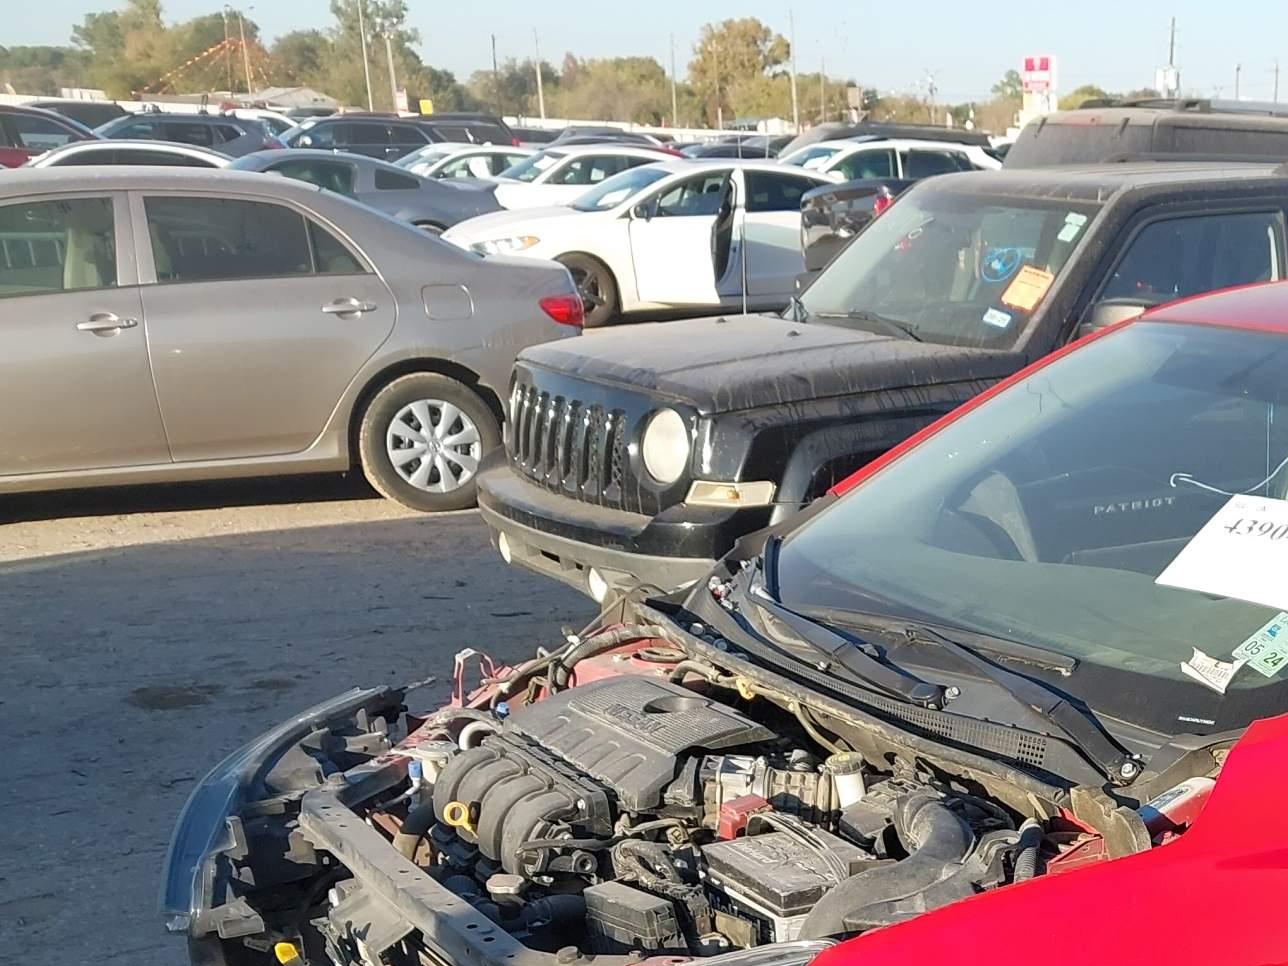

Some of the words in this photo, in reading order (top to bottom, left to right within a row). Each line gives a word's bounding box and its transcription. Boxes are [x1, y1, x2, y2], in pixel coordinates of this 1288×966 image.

[1093, 496, 1175, 515] PATRIOT
[1245, 641, 1265, 656] 05
[1264, 652, 1285, 668] 24
[603, 703, 667, 736] NISSAN
